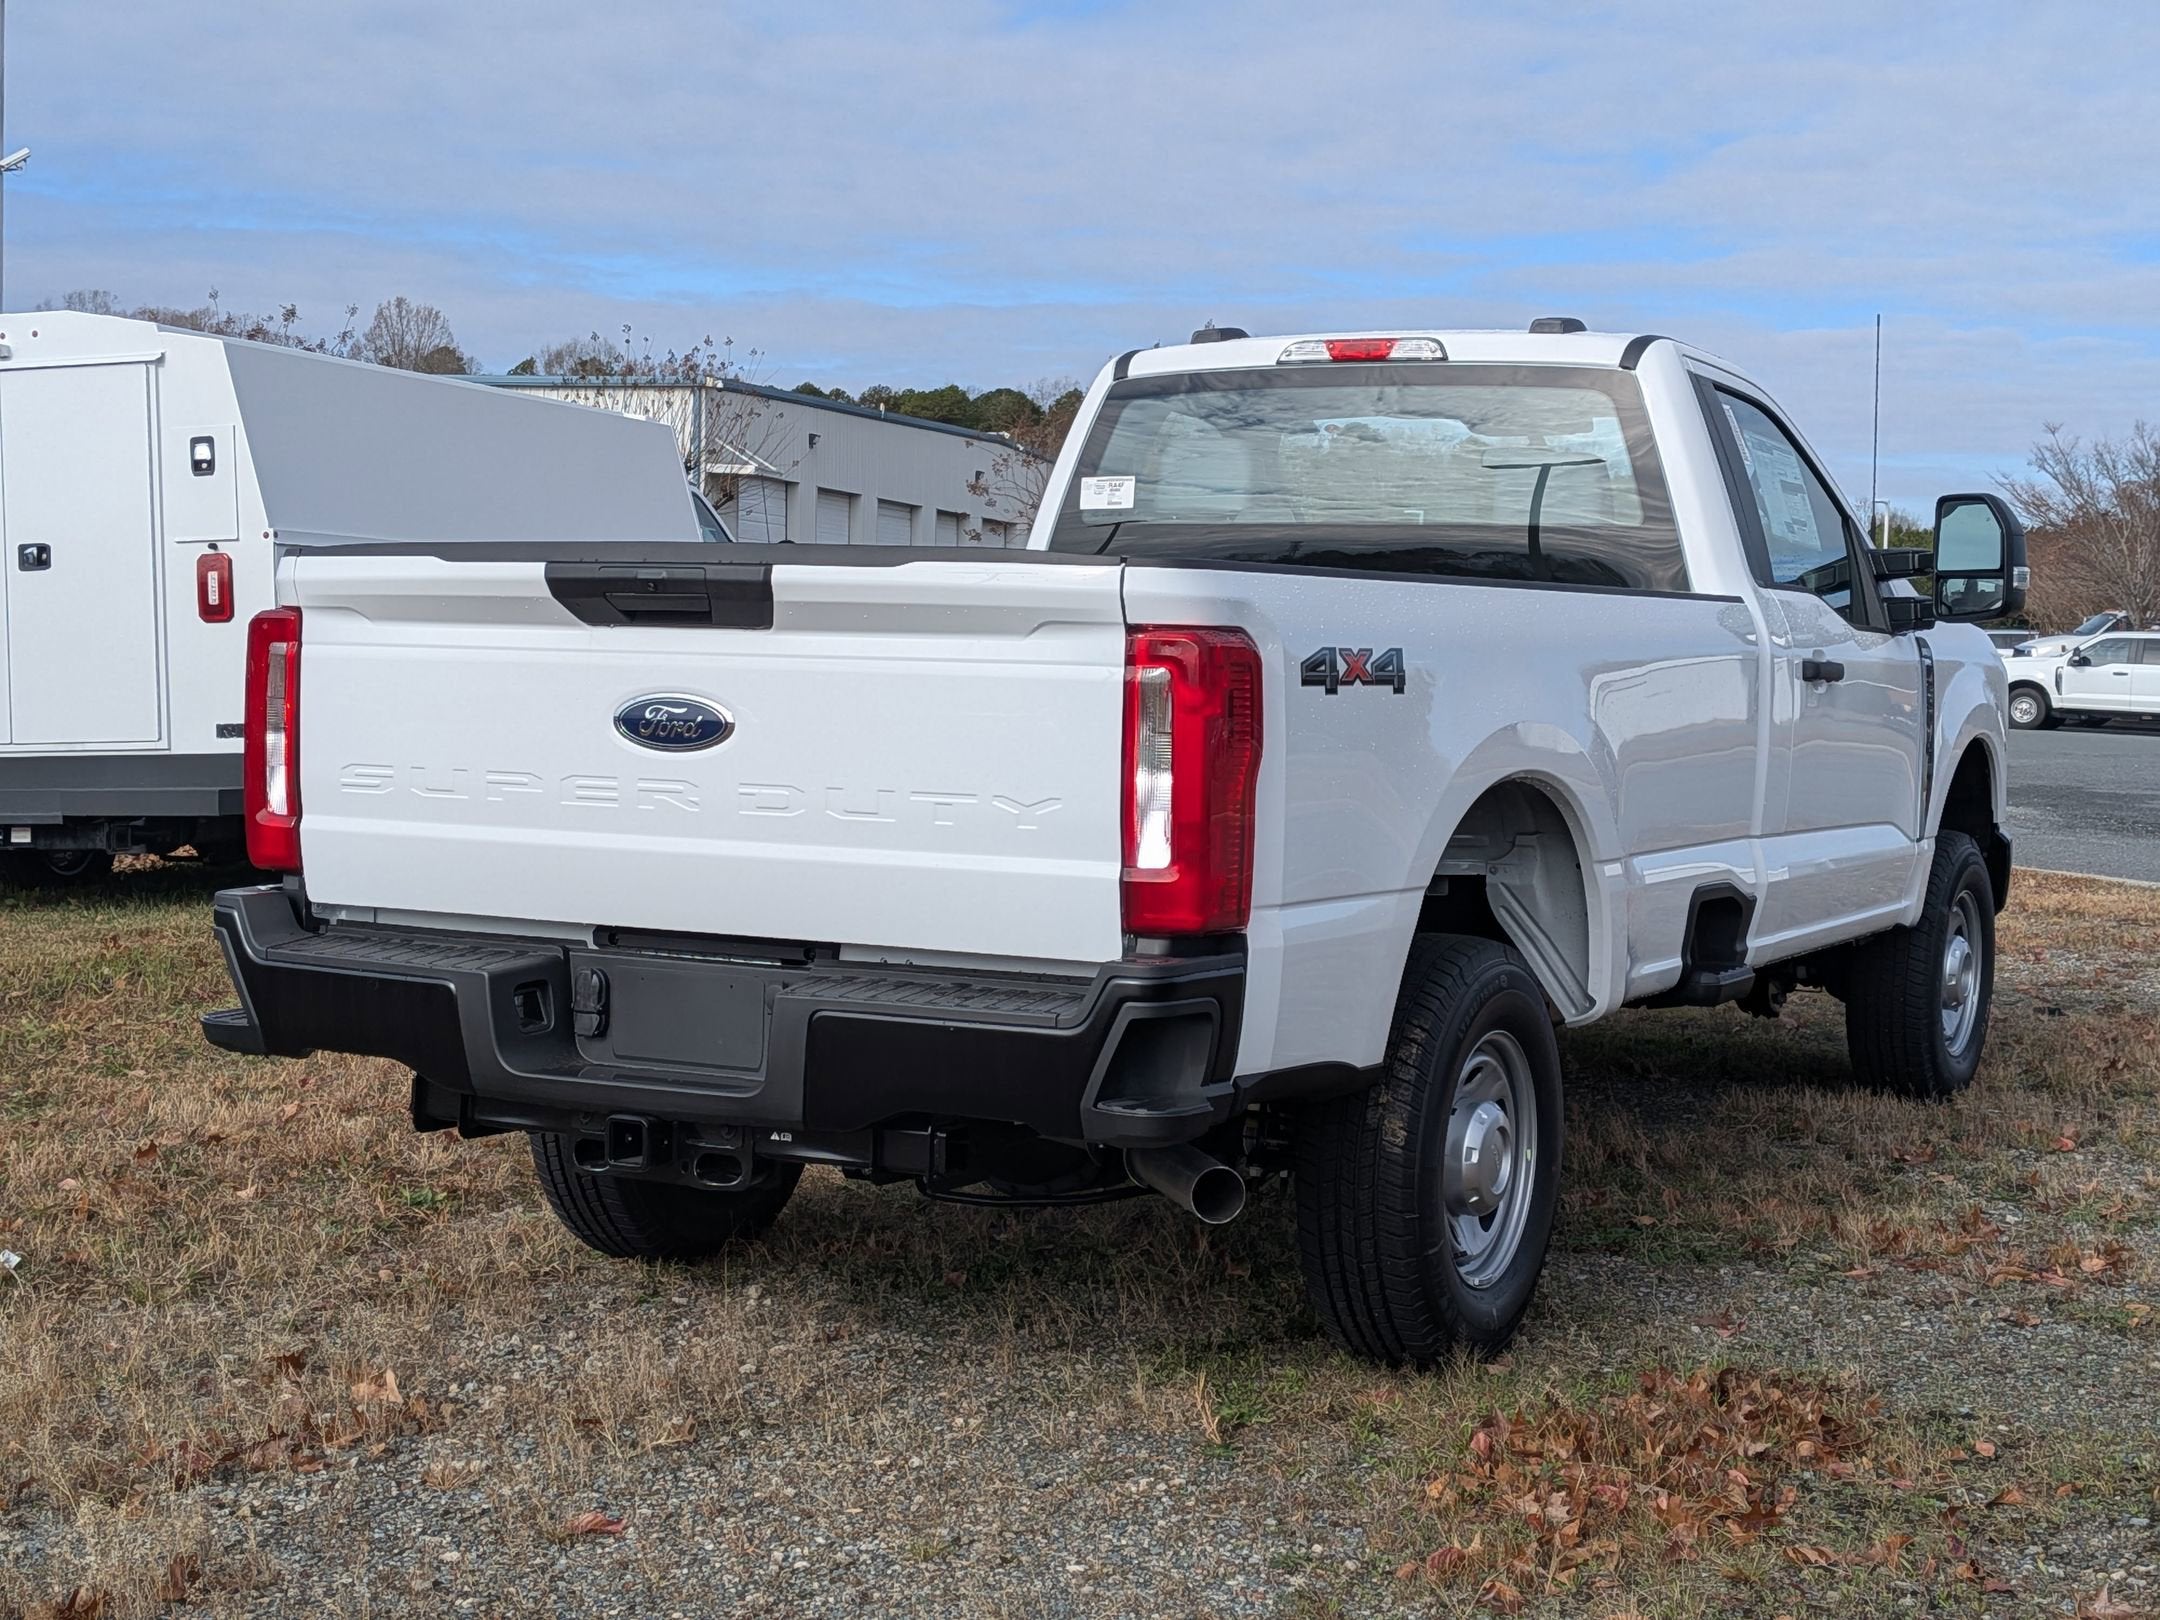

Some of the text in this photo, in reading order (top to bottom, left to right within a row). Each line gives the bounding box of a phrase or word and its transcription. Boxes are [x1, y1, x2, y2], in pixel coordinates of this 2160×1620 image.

[639, 704, 702, 738] Ford
[340, 763, 1063, 829] SUPER DUTY
